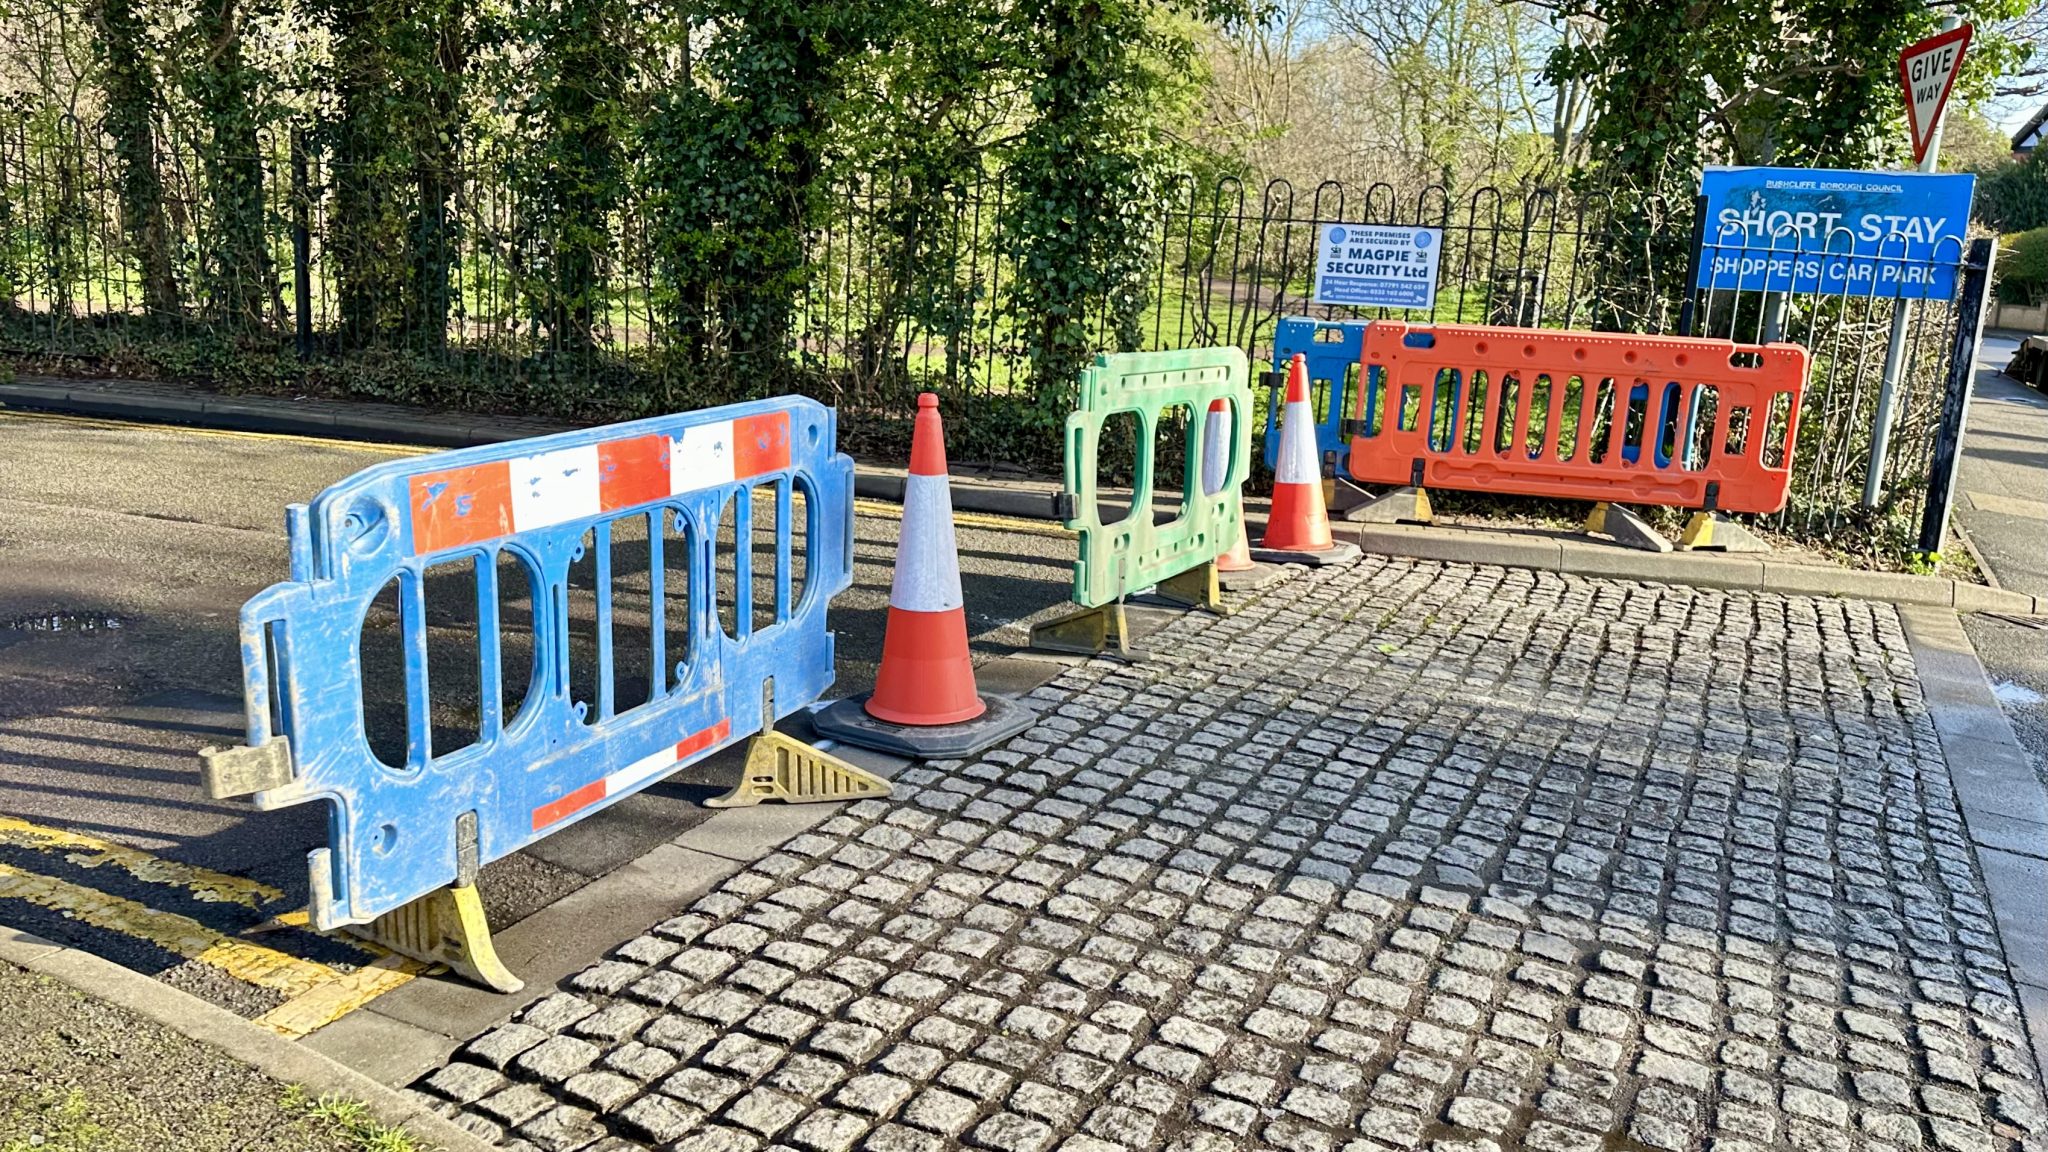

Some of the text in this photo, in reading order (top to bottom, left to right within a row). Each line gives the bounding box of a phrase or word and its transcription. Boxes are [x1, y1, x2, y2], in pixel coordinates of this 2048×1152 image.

[1911, 48, 1953, 83] GIVE
[1916, 82, 1942, 104] WAY
[1765, 180, 1904, 193] RUSHCLIFFE BOROUGH COUNCIL
[1716, 208, 1946, 244] SHORT STAY
[1365, 238, 1398, 246] SECURED
[1374, 231, 1411, 239] PREMISES
[1348, 248, 1411, 262] MAGPIE
[1326, 262, 1428, 278] SECURITY Ltd
[1710, 257, 1936, 284] SHOPPERS CAR PARK
